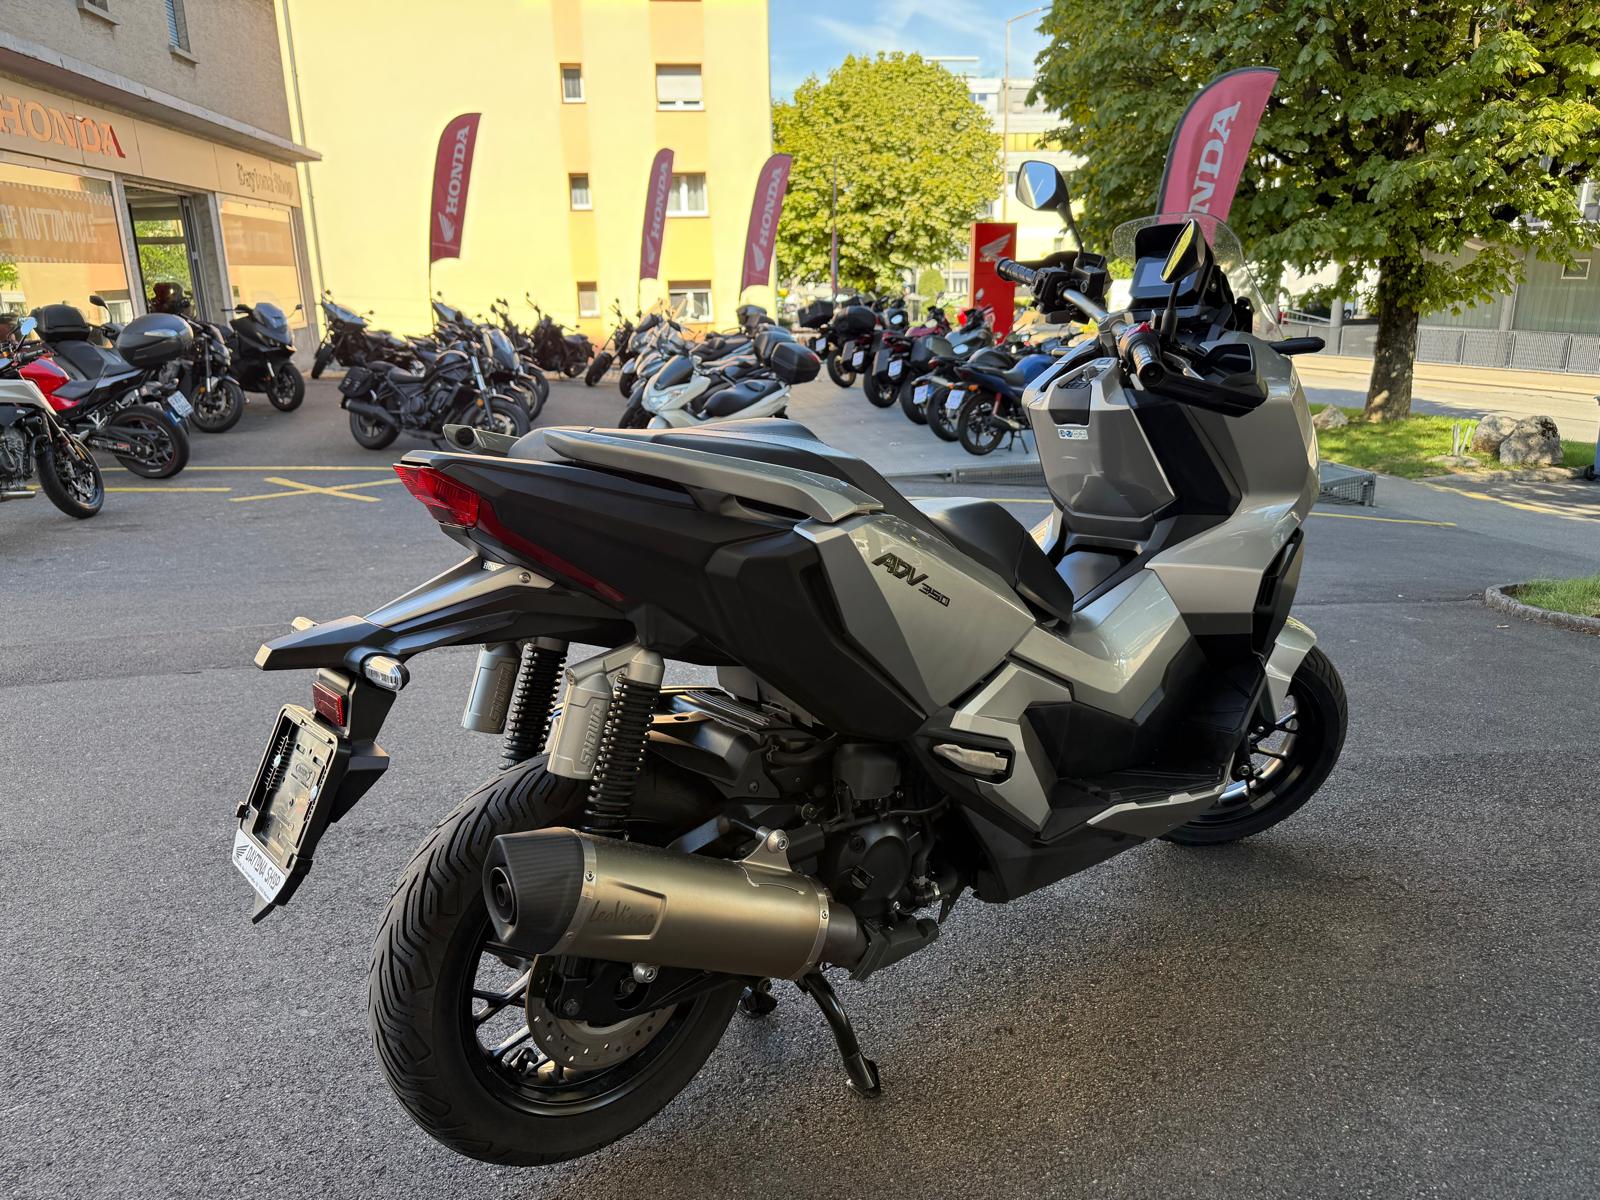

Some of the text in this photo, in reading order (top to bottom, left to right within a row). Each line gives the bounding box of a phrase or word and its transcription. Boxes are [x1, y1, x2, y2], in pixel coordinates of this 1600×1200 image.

[0, 95, 126, 159] HONDA
[1187, 101, 1241, 214] NDA
[445, 125, 470, 215] HONDA
[650, 162, 669, 239] HONDA
[759, 167, 783, 247] HONDA
[872, 552, 951, 607] ADV 350
[245, 846, 267, 877] DAYTONA
[265, 867, 281, 890] SHOP
